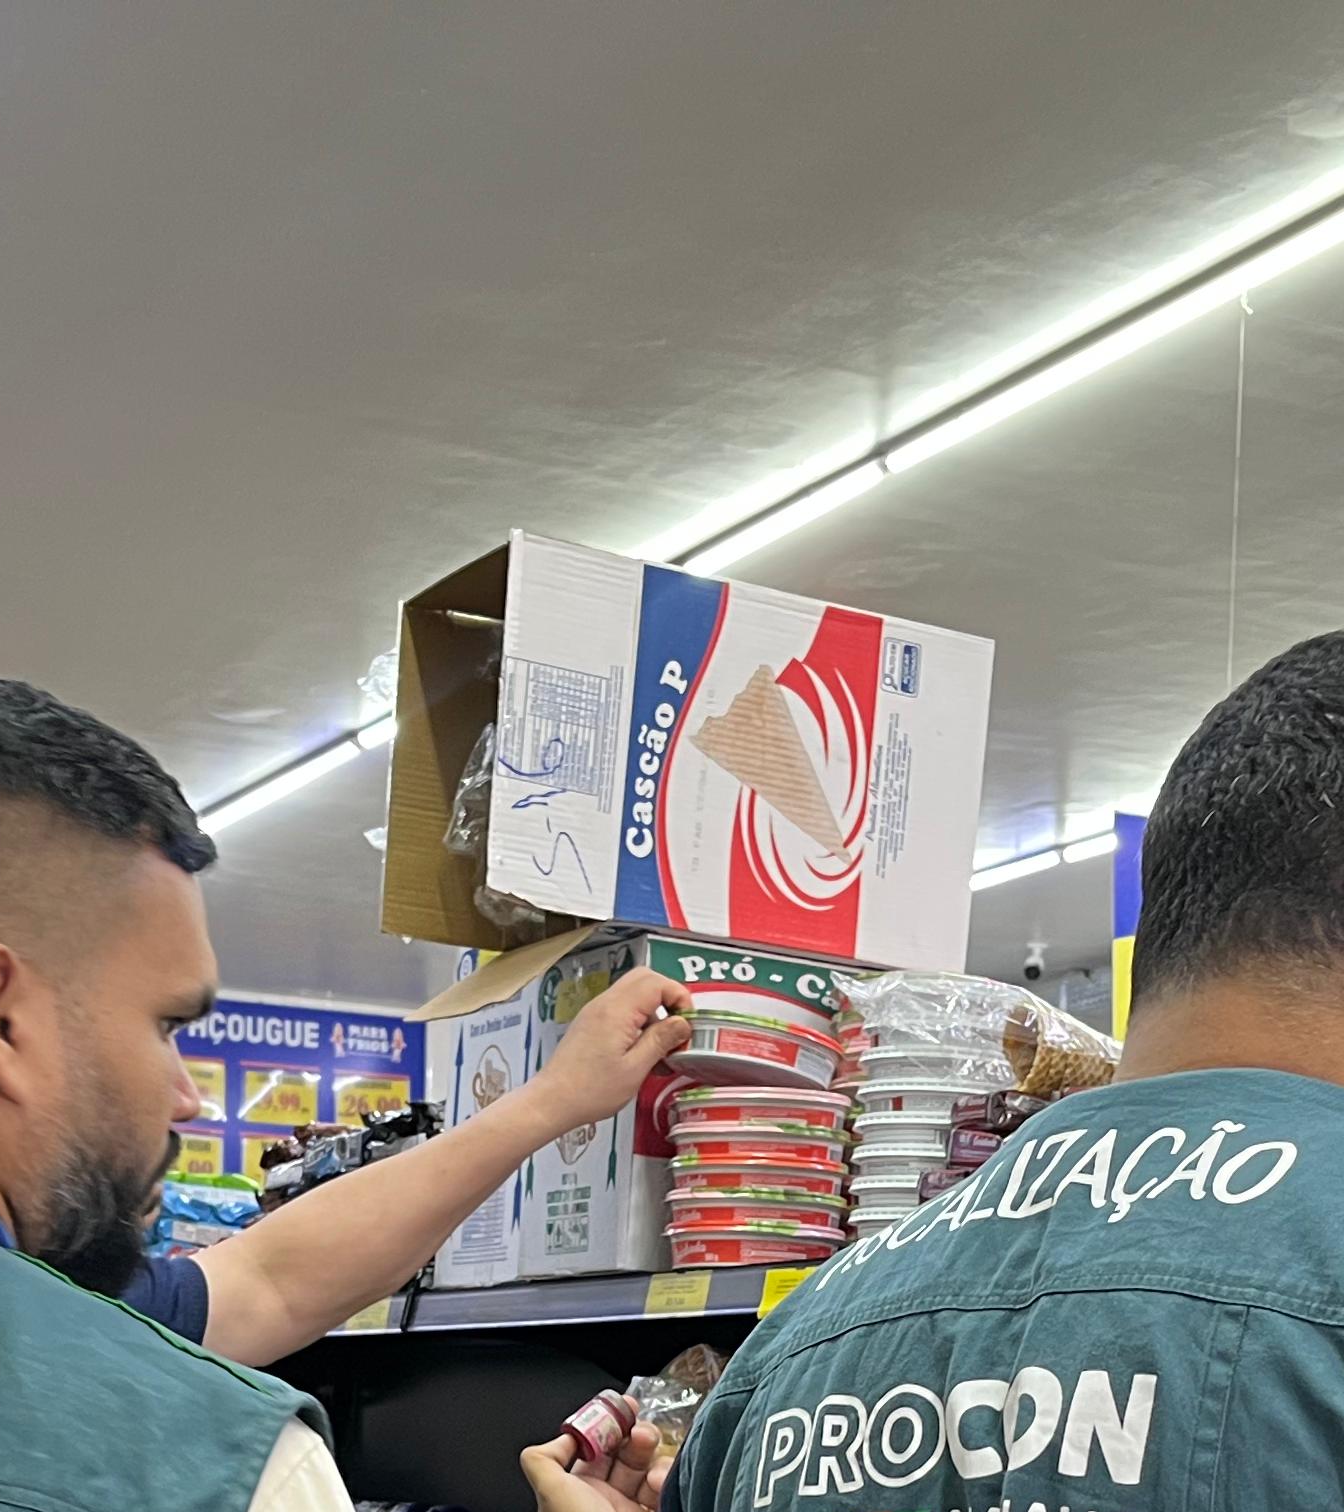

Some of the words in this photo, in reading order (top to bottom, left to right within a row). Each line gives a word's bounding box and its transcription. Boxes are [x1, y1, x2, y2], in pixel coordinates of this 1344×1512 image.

[627, 709, 676, 859] Cascão
[662, 659, 689, 696] P
[678, 955, 756, 982] Pró
[753, 1366, 1158, 1508] PROCON
